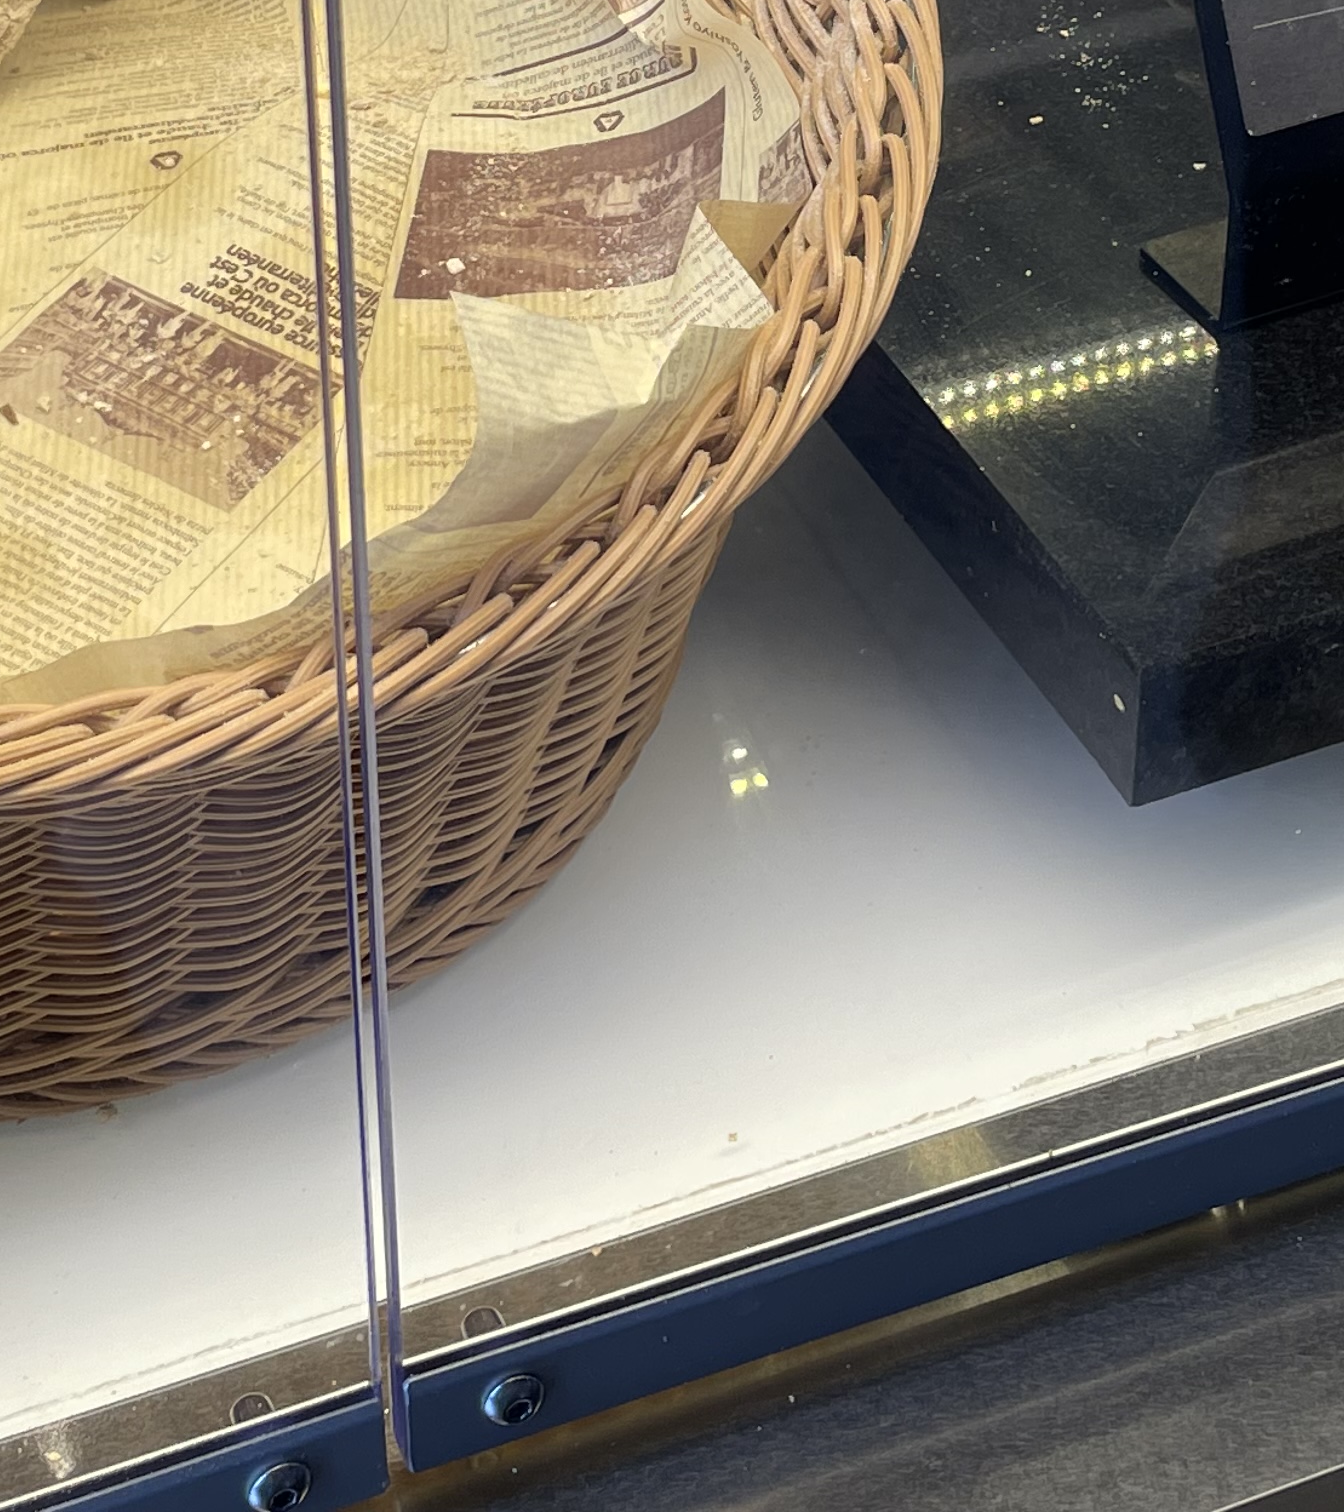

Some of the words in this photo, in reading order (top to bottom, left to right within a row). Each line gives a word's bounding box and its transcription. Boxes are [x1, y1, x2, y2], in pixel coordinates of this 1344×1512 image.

[207, 270, 229, 295] et
[210, 256, 253, 283] C'est
[253, 273, 279, 300] où
[181, 283, 284, 334] européenne
[229, 285, 294, 320] chaude
